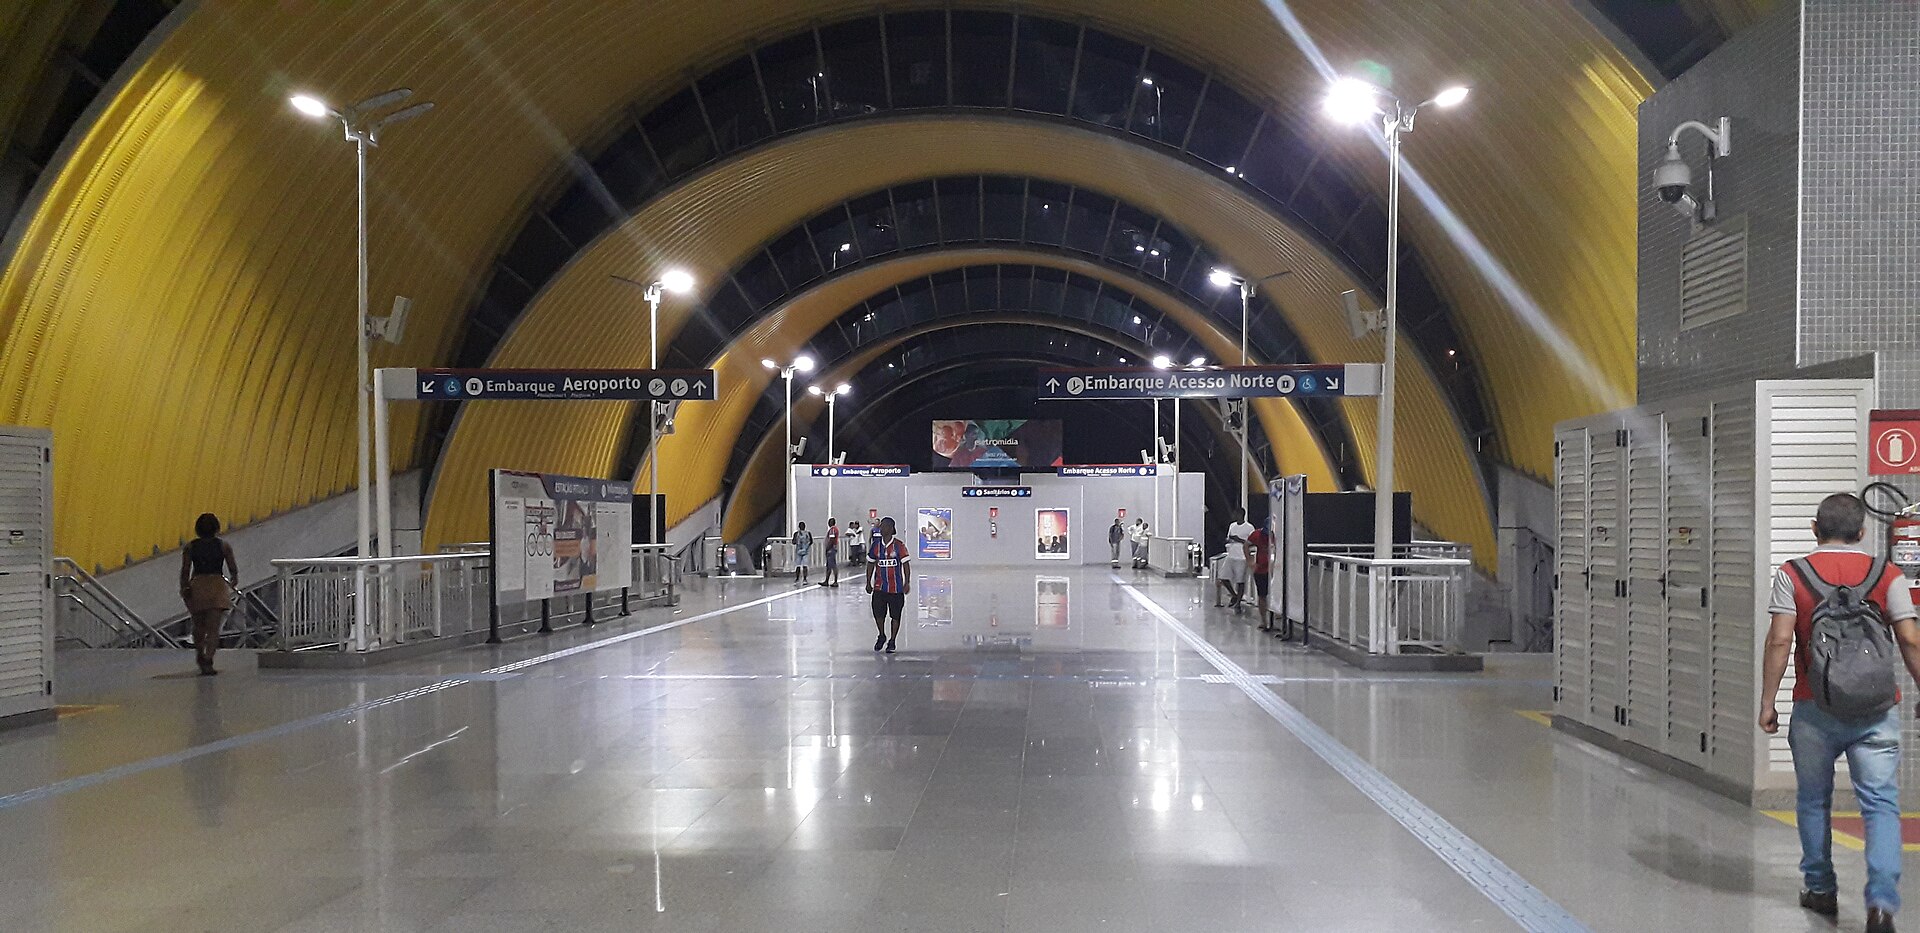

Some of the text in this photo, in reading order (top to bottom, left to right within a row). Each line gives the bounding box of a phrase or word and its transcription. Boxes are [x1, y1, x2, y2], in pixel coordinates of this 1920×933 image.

[487, 377, 641, 394] Embarque Aeroporto
[1085, 373, 1275, 391] Embarque Acesso Norte
